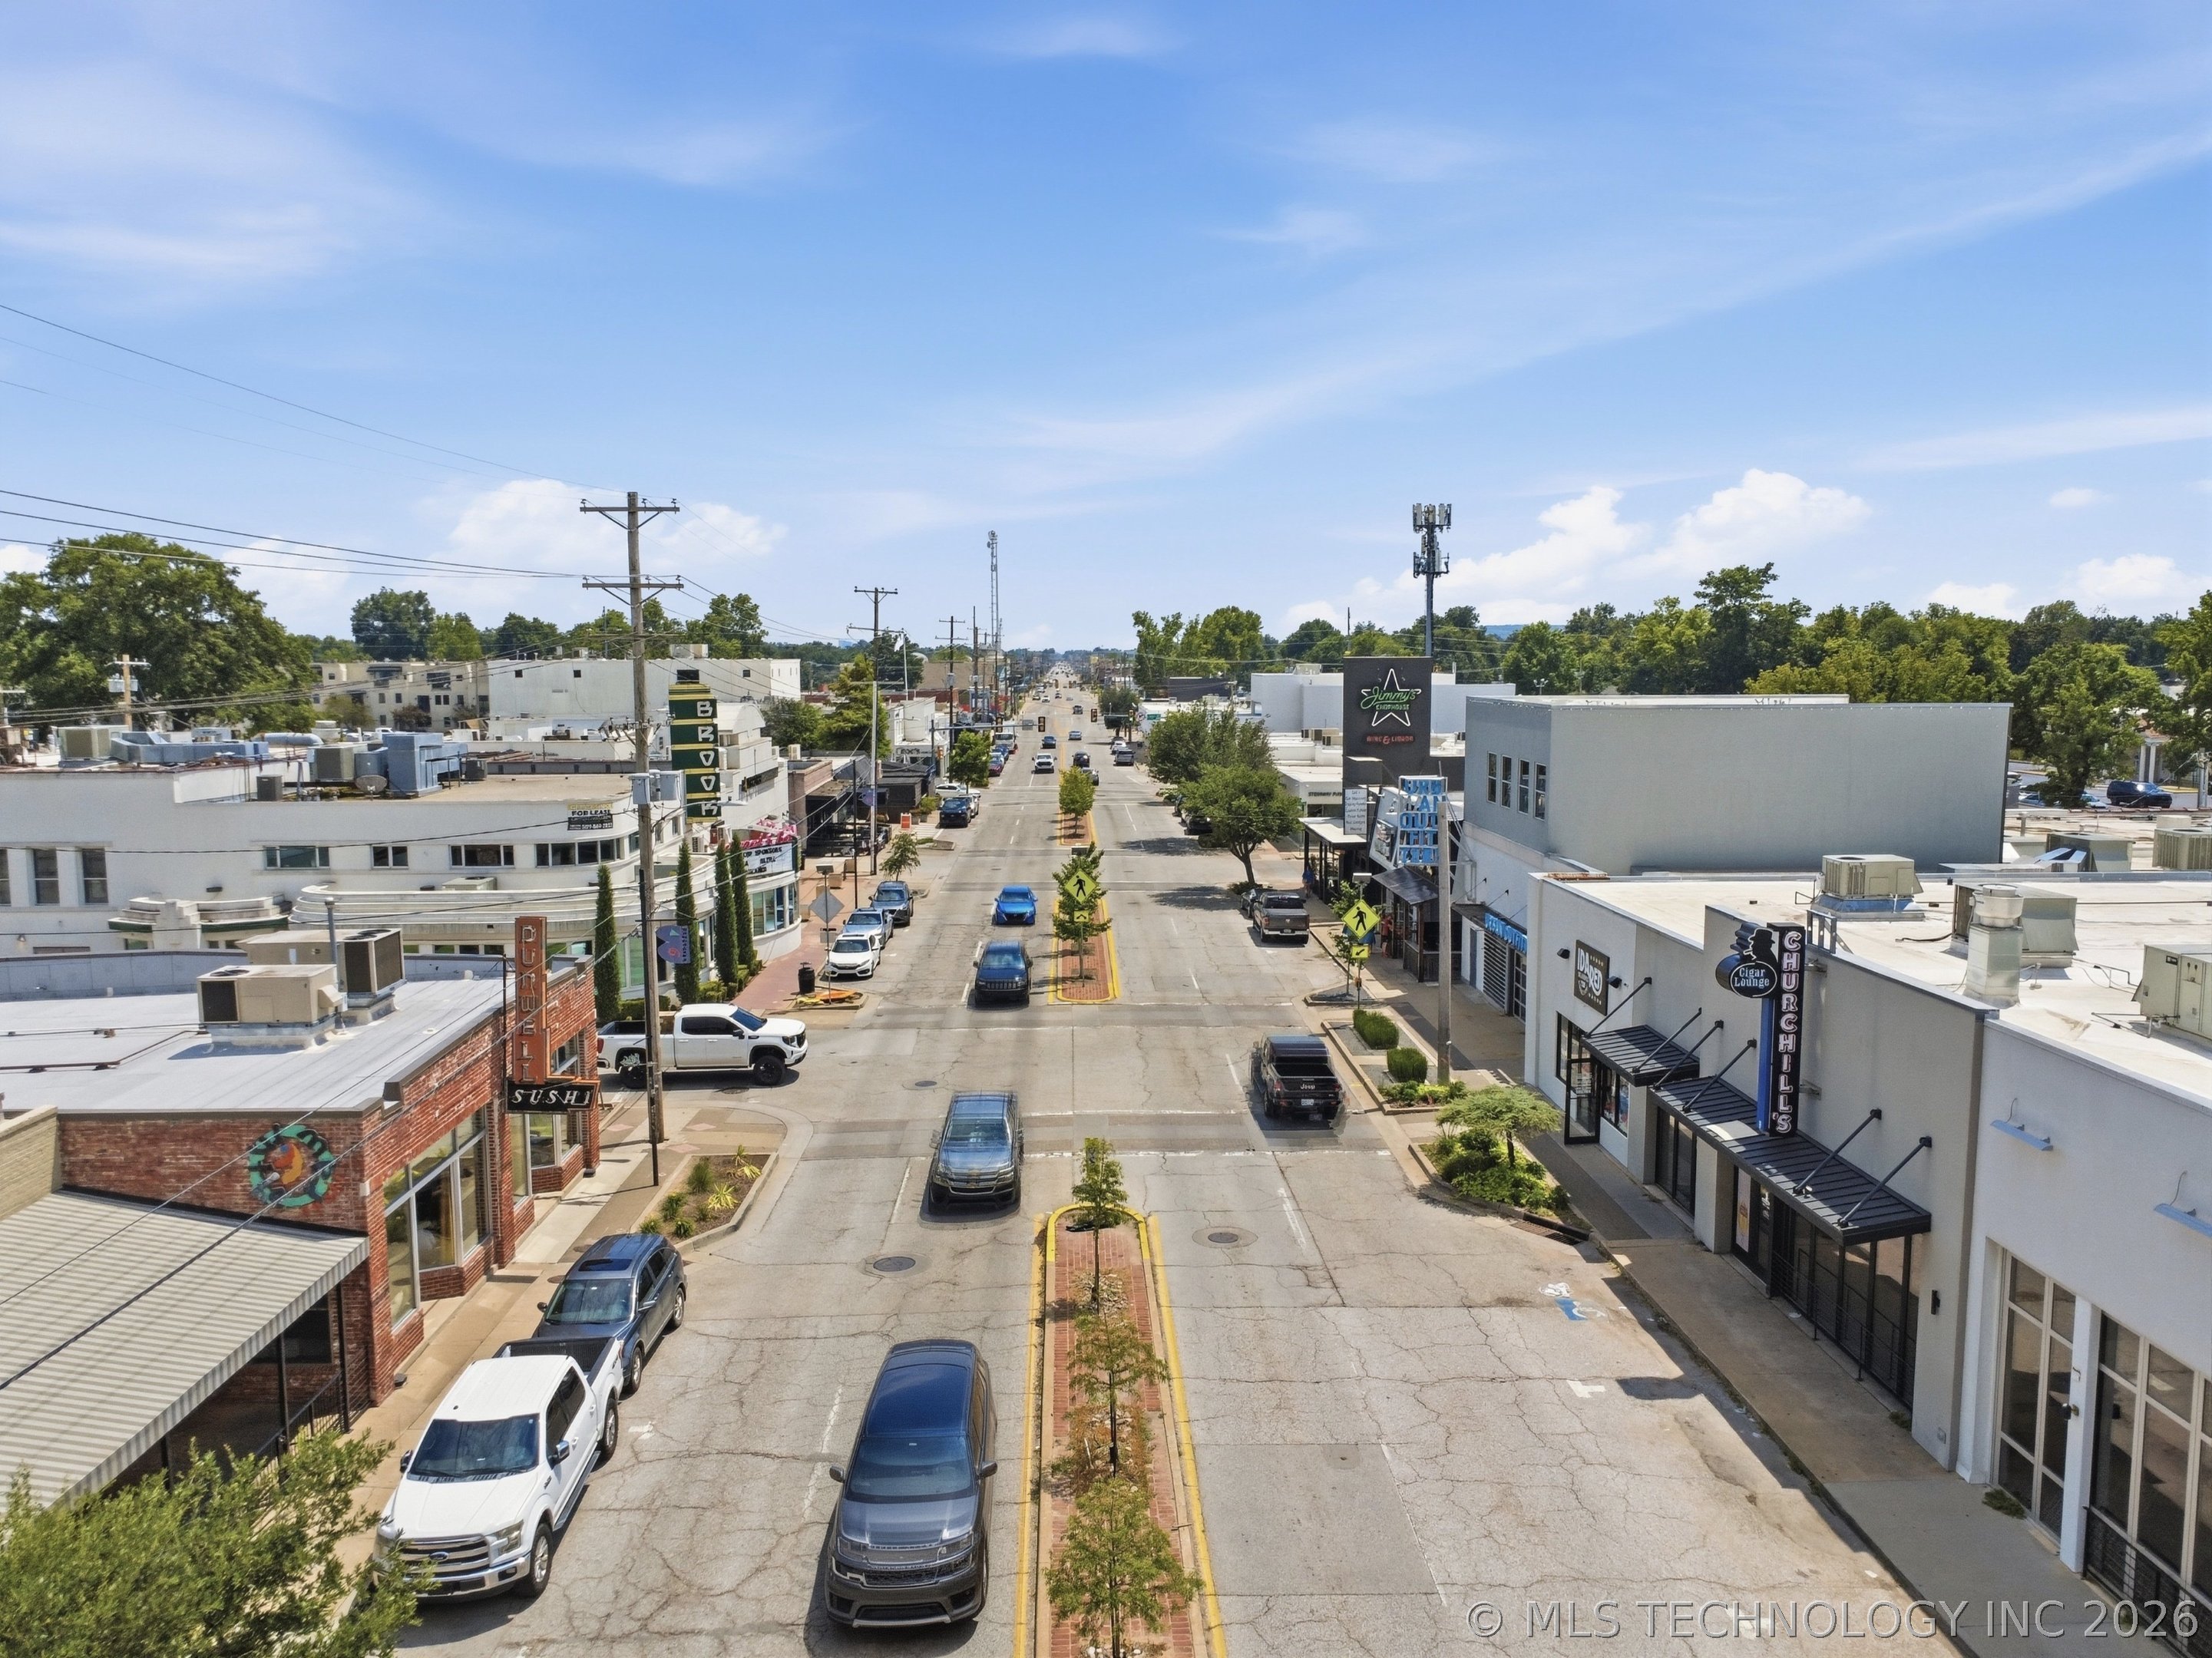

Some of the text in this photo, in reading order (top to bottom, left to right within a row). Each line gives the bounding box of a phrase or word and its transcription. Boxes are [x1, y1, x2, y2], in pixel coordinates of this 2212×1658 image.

[1361, 686, 1416, 709] Jimmy's
[696, 700, 719, 816] BROOK
[1734, 977, 1770, 989] Lounge
[1739, 968, 1765, 979] Cigar
[1773, 931, 1802, 1134] CHURCHILL'S
[511, 1089, 591, 1105] SUSHI
